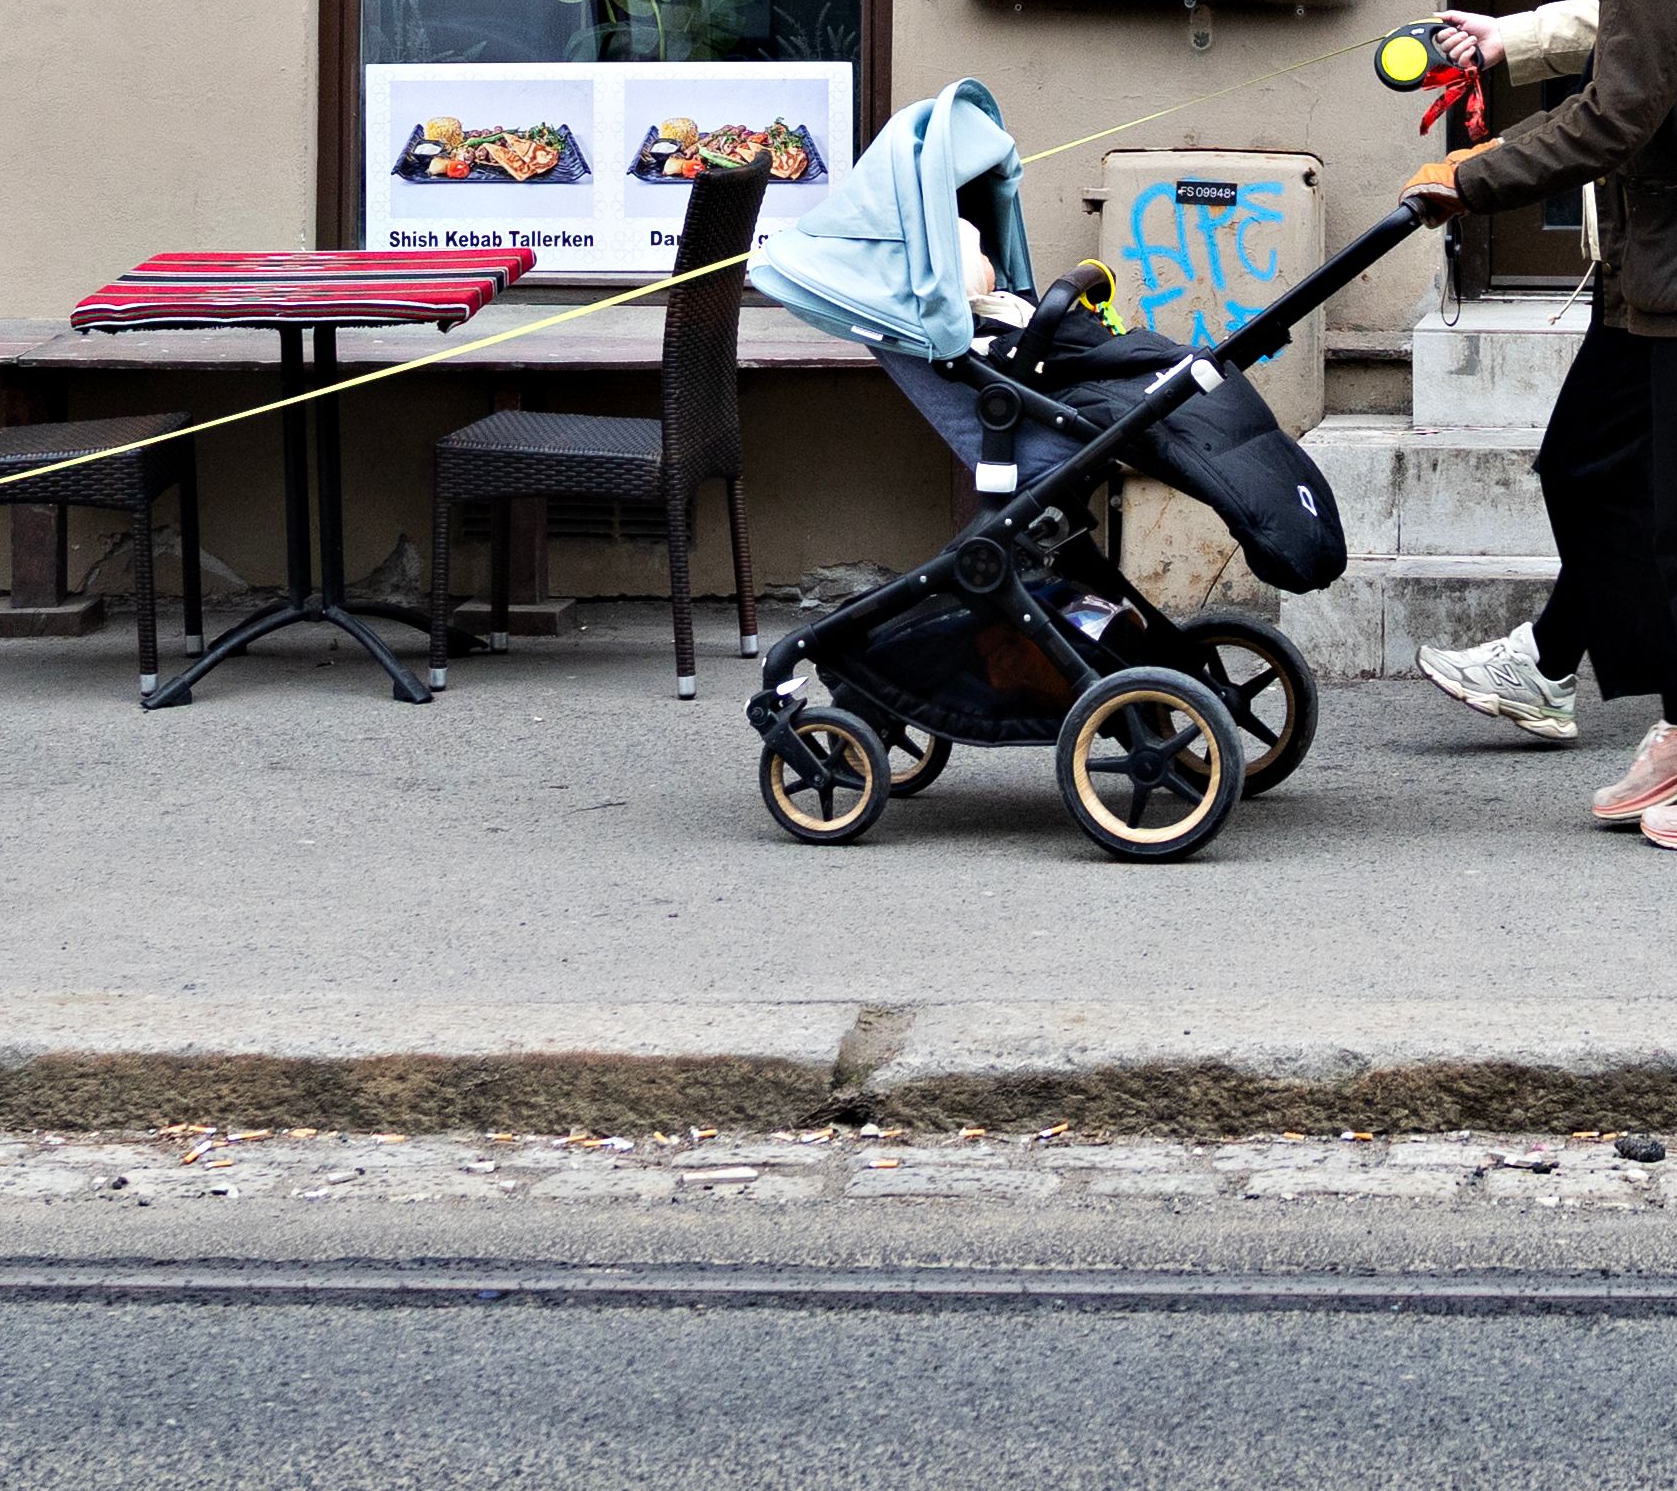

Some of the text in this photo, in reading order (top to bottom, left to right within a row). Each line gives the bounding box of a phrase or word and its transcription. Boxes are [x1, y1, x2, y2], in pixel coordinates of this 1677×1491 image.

[1180, 186, 1231, 199] FS 09948
[389, 230, 594, 248] Shish Kebab Tallerken
